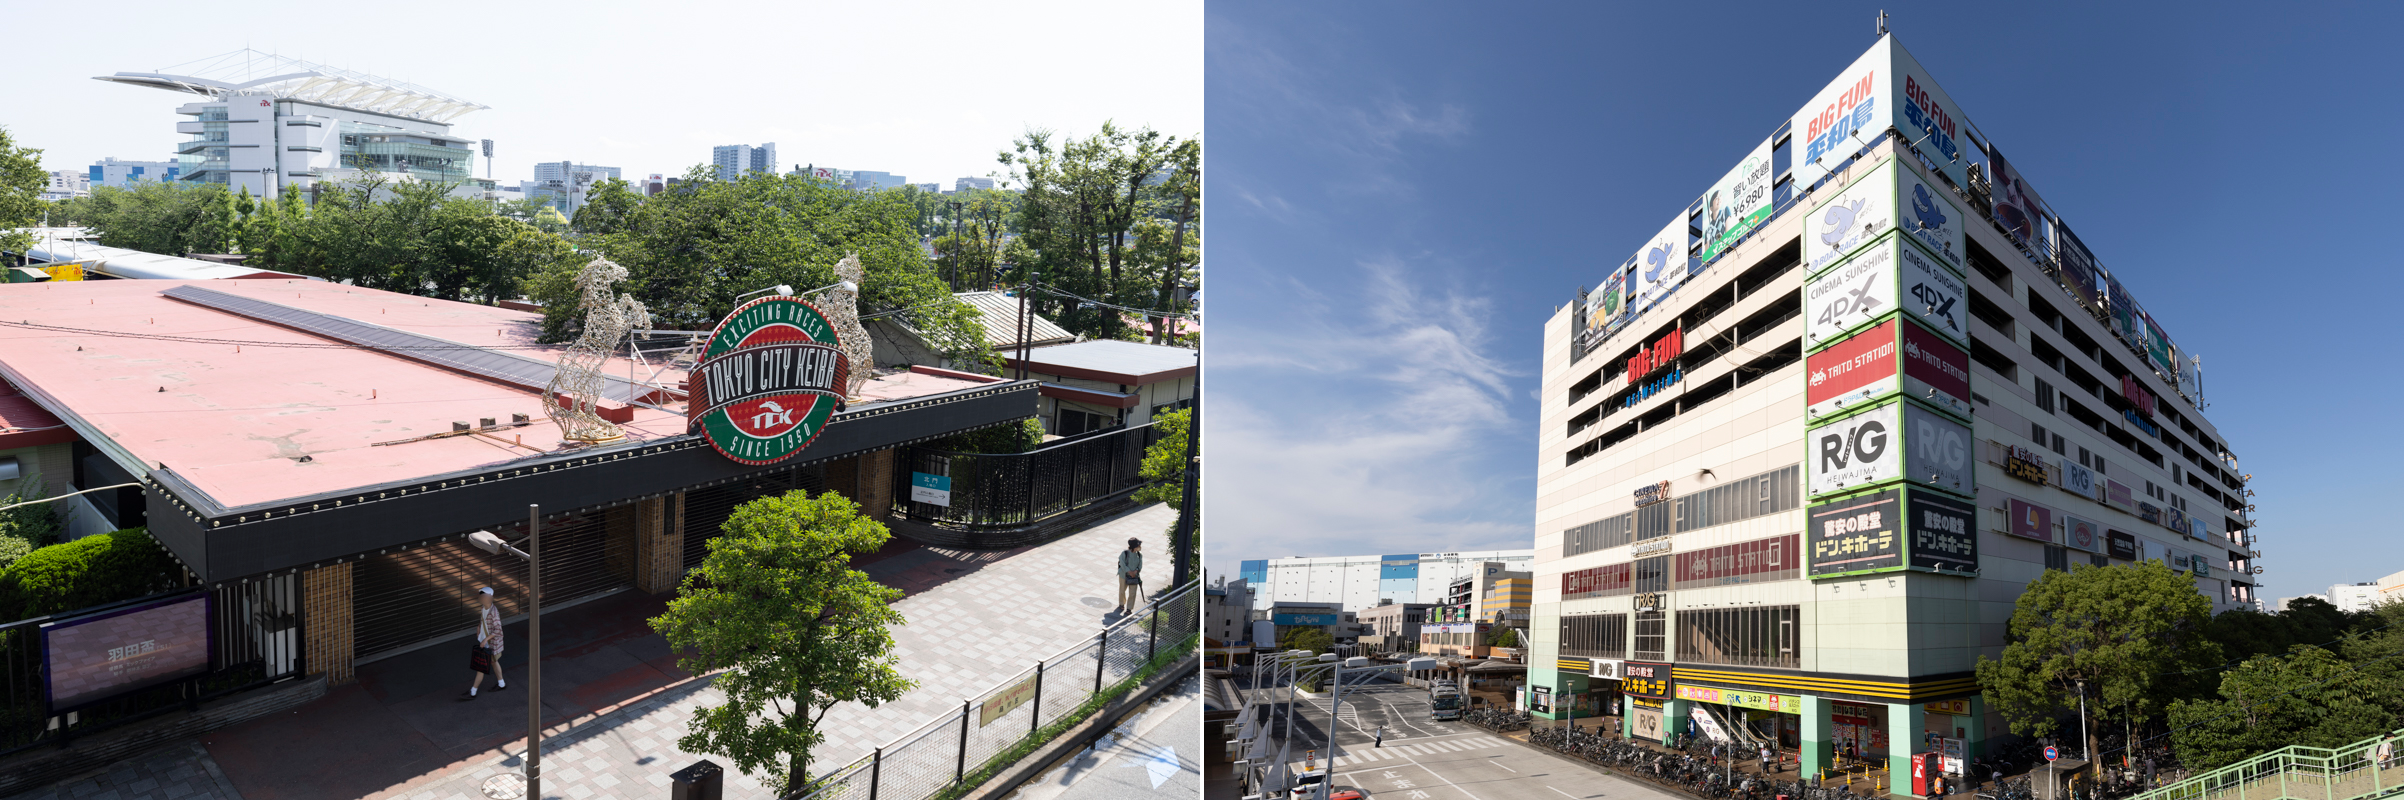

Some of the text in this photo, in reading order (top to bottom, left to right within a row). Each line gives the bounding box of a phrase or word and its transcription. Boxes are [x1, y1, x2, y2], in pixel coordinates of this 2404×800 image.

[1807, 70, 1873, 144] BIG FUN
[1906, 74, 1956, 141] BIG FUN
[1805, 96, 1874, 167] 平和島
[1905, 96, 1957, 165] 平和島
[1927, 235, 1943, 251] RACE
[1811, 249, 1889, 300] CINEMA SUNSHINE
[1904, 249, 1963, 298] CINEMA SUNSHINE
[1818, 272, 1883, 325] 4DX
[1911, 282, 1960, 333] 4DX
[723, 303, 823, 348] EXCITING RACES
[1627, 327, 1682, 384] BIG FUN
[1827, 341, 1894, 379] TAITO STATION
[1921, 349, 1968, 384] TAITO STATION
[702, 348, 838, 406] TOKYO CITY KEIBA
[1626, 369, 1681, 408] HEIWAJIMA
[2122, 374, 2154, 417] BIG FUN
[751, 407, 794, 429] TCK
[730, 422, 811, 457] SINCE 1950
[1658, 479, 1668, 499] 7
[1826, 466, 1877, 485] HEIWAJIMA
[1923, 464, 1960, 482] HEIWAJIMA
[1824, 511, 1882, 538] 驚安の殿堂
[1924, 510, 1965, 535] 驚安の殿堂
[2245, 474, 2264, 575] PARKING
[1487, 567, 1498, 576] P
[1709, 548, 1780, 571] TAITO STATION
[107, 639, 155, 662] 羽田盃
[1383, 770, 1431, 800] 止まれ
